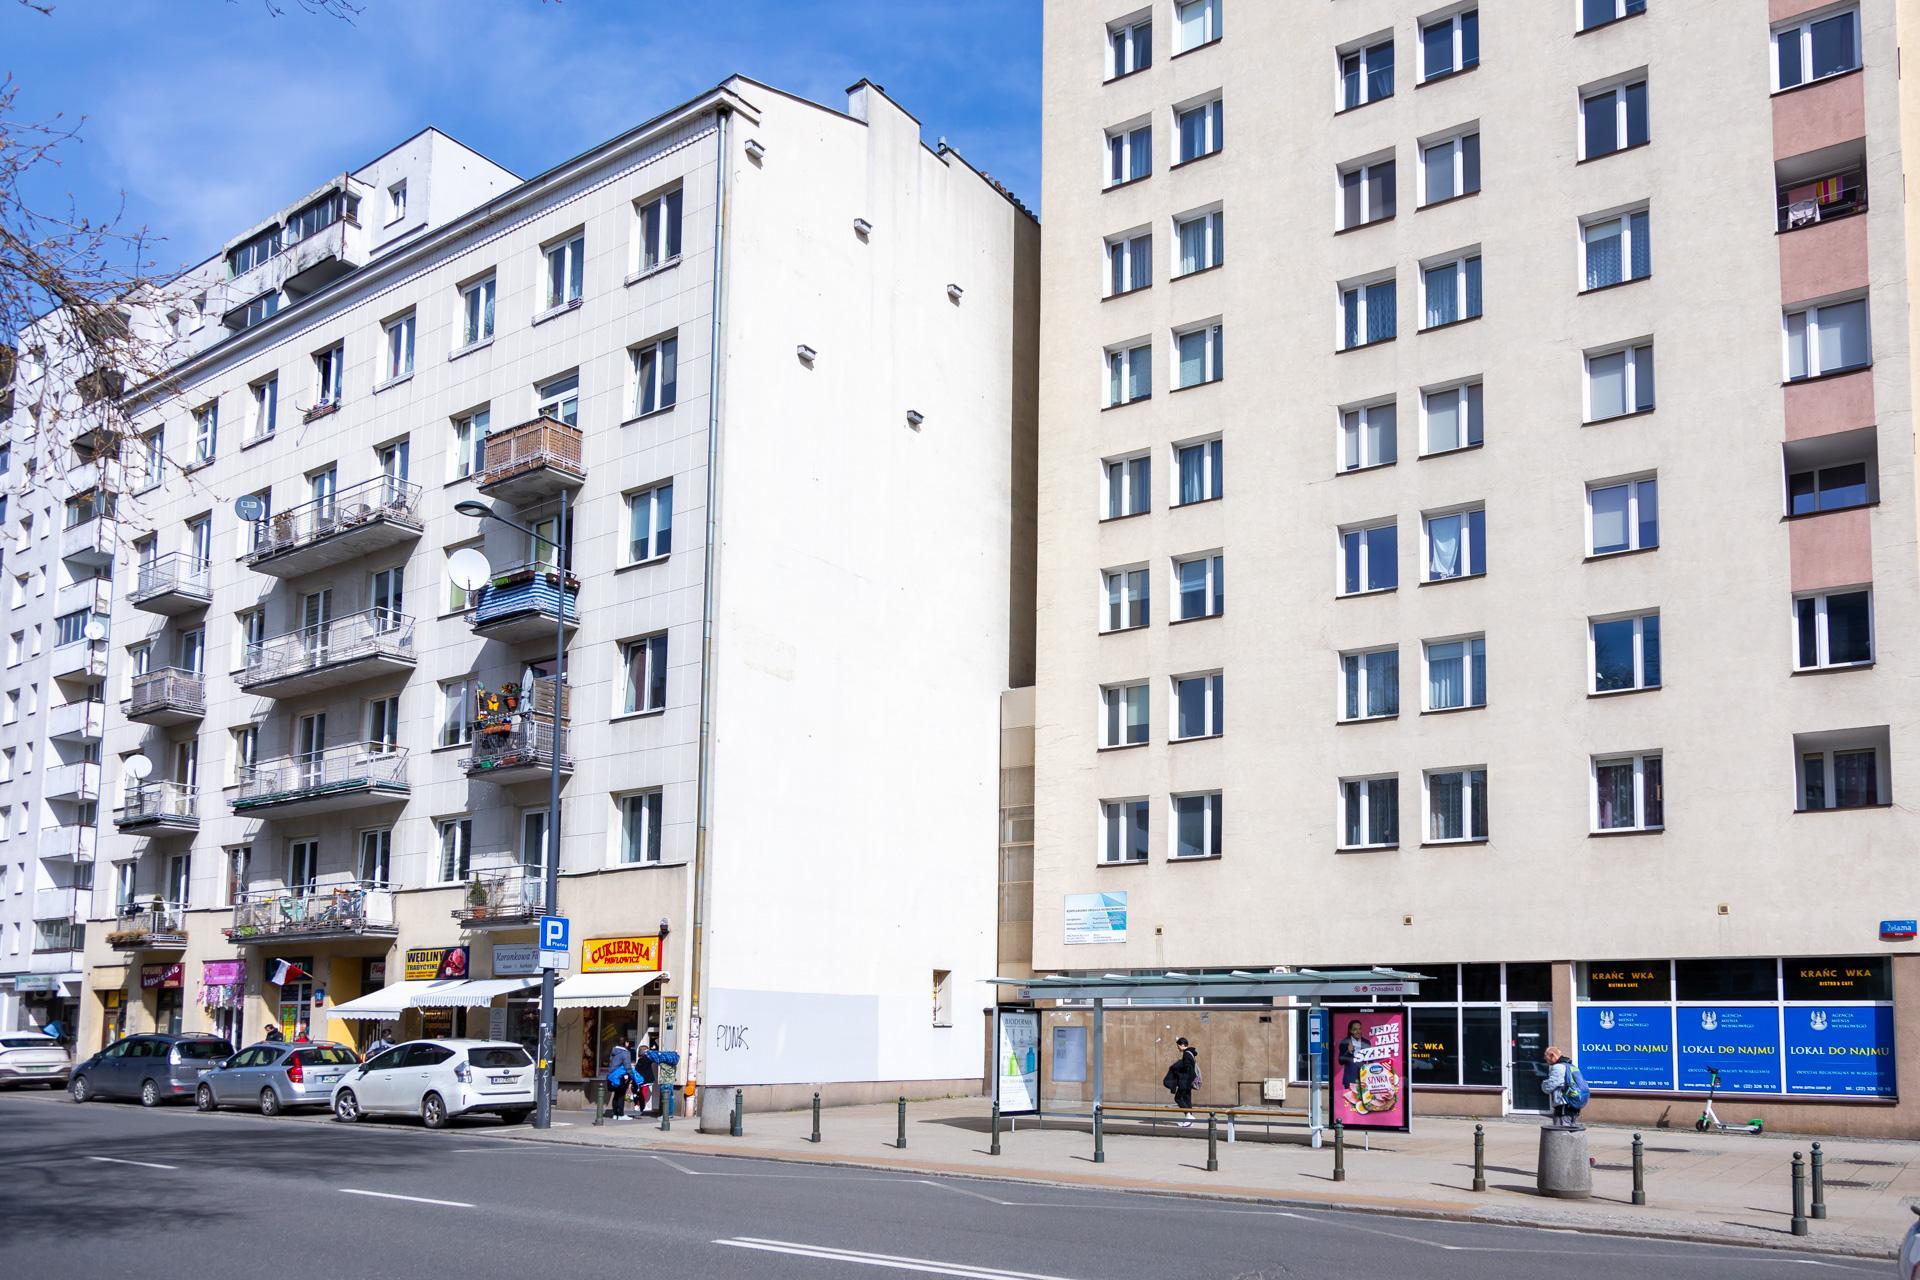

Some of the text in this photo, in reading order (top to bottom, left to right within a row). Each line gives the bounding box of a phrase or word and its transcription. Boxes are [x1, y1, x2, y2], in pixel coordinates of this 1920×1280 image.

[546, 920, 563, 946] P
[407, 951, 444, 964] WĘDLINY
[591, 940, 650, 964] CUKIERNIA
[1369, 1022, 1400, 1036] JEDZ
[716, 1024, 749, 1051] PUNK
[1376, 1033, 1400, 1046] JAK
[1353, 1043, 1399, 1063] SZEF!
[1582, 1043, 1669, 1053] LOKAL DO NAJMU
[1682, 1045, 1775, 1056] LOKAL DO NAJMU
[1790, 1046, 1890, 1057] LOKAL DO NAJMU
